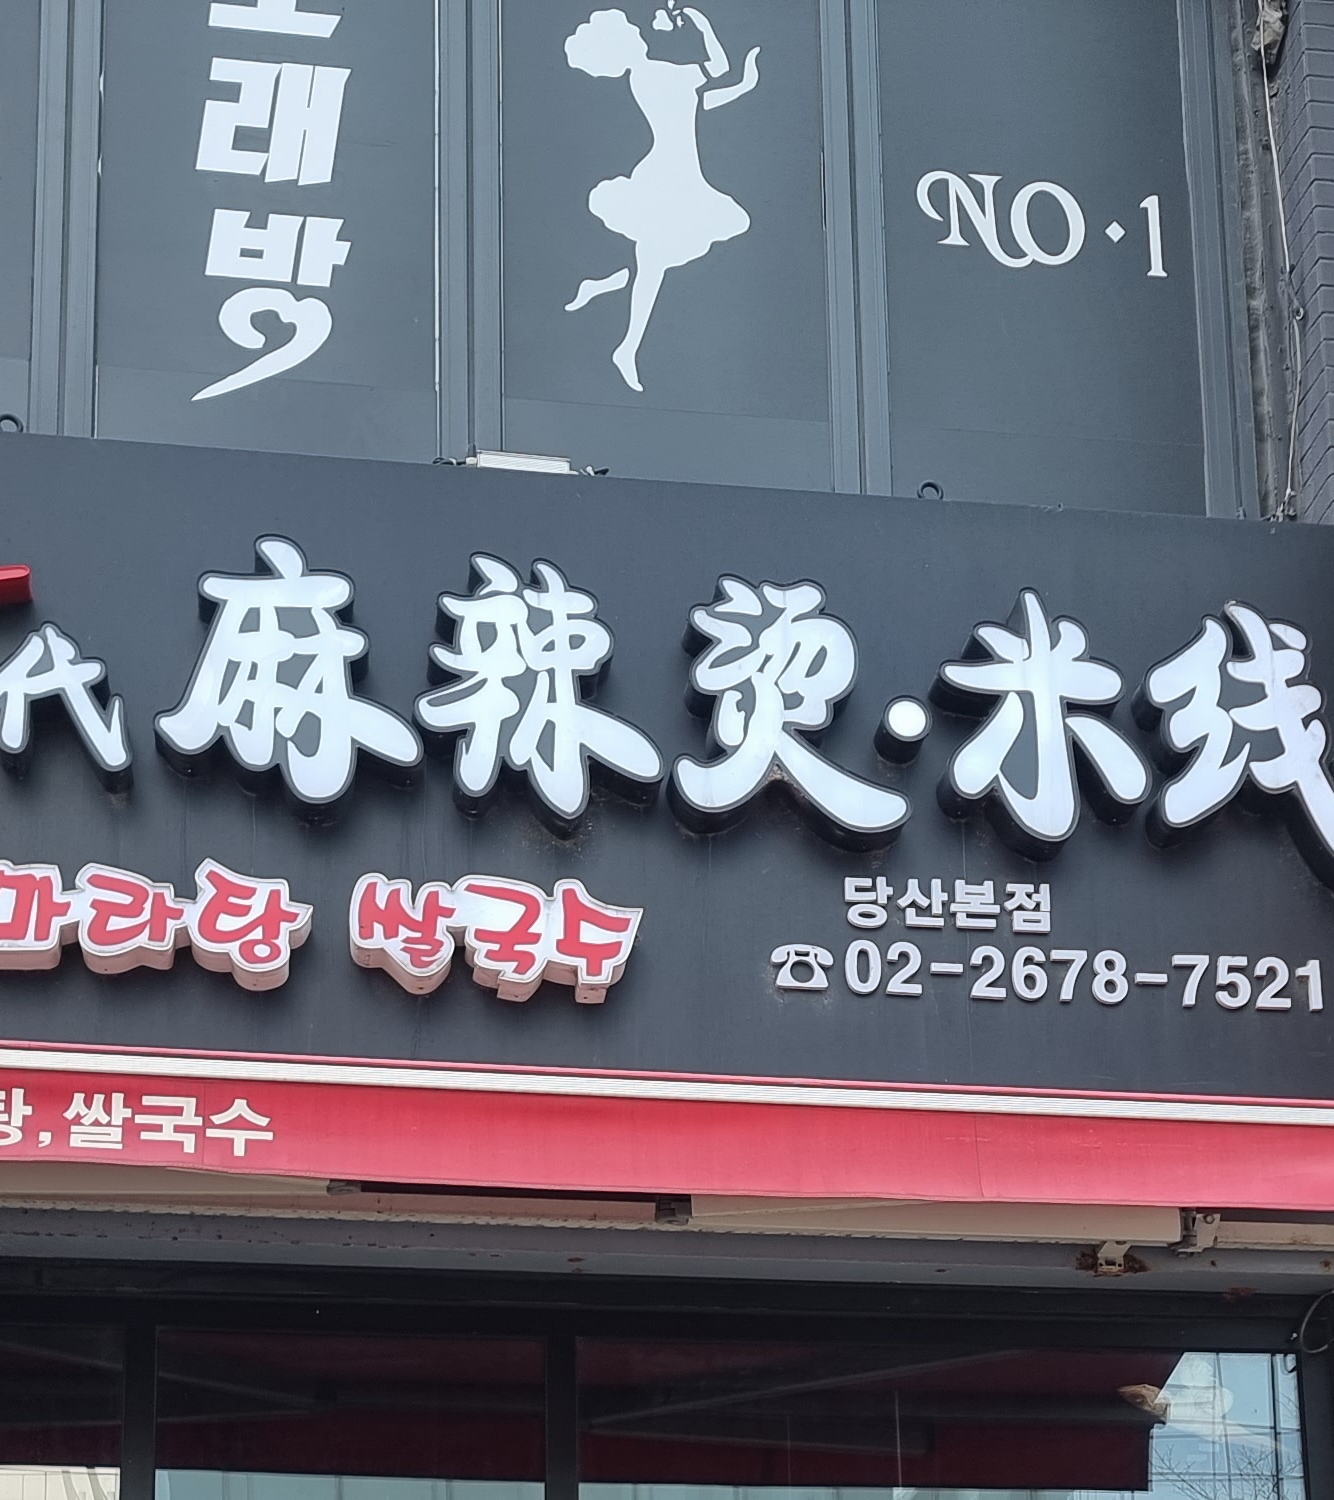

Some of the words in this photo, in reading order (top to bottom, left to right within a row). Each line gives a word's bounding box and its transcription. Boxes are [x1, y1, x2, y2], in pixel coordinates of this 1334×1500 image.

[350, 872, 643, 1000] 쌀국수
[843, 875, 1053, 933] 당산본점
[844, 940, 1325, 1012] 02-2678-7521
